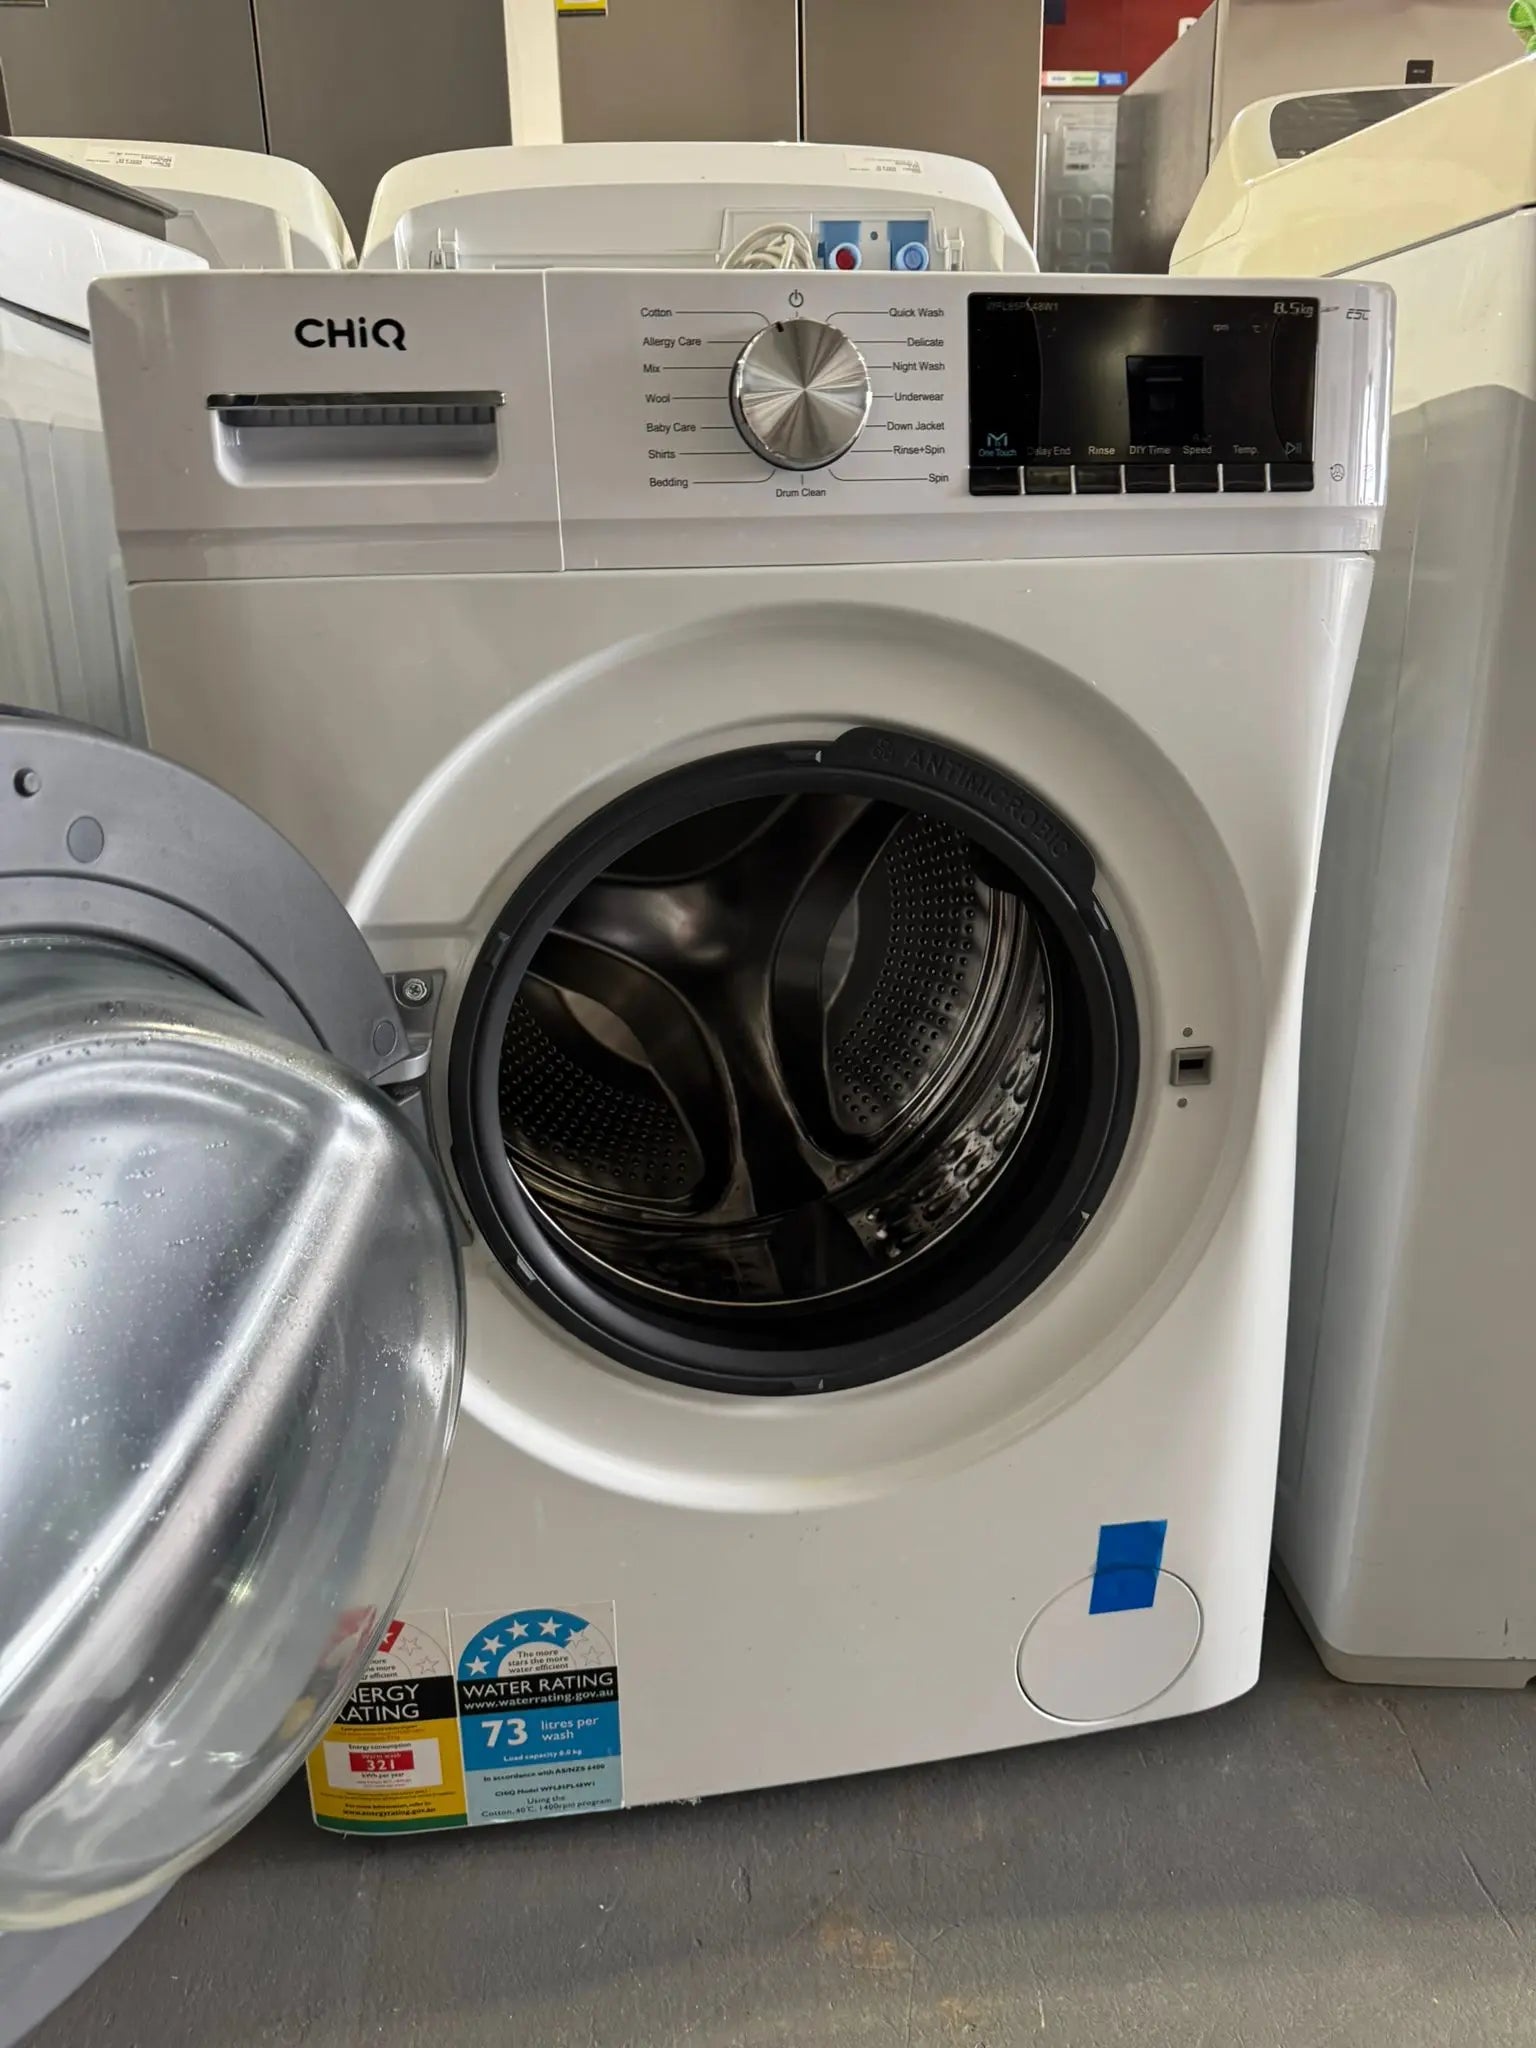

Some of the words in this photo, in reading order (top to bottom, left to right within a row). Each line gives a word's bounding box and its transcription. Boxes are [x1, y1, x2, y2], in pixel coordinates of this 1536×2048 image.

[640, 307, 673, 318] Cotton
[889, 307, 915, 318] Quick
[918, 307, 944, 317] Wash
[295, 316, 407, 351] CHiQ
[643, 336, 675, 348] Allergy
[678, 336, 702, 346] Care
[907, 337, 944, 347] Delicate
[643, 364, 660, 374] Mix
[892, 362, 916, 373] Night
[919, 362, 945, 371] Wash
[645, 394, 670, 403] Wool
[894, 392, 944, 401] Underwear
[646, 422, 671, 435] Baby
[674, 422, 696, 432] Care
[887, 421, 913, 431] Down
[915, 421, 945, 430] Jacket
[648, 450, 676, 459] Shirts
[893, 445, 945, 456] Rinse+Spin
[978, 448, 994, 457] One
[995, 448, 1017, 457] Touch
[1027, 446, 1052, 458] Delay
[1054, 445, 1072, 455] End
[1088, 445, 1116, 455] Rinse
[1129, 444, 1147, 455] DIY
[1149, 444, 1171, 455] Time
[1183, 445, 1213, 456] Speed
[649, 478, 688, 489] Bedding
[928, 473, 949, 484] Spin
[776, 488, 799, 498] Drum
[801, 488, 826, 497] Clean
[508, 1659, 528, 1667] stars
[535, 1662, 569, 1671] efficient
[463, 1679, 533, 1699] WATER
[539, 1672, 614, 1692] RATING
[349, 1684, 419, 1703] NERGY
[464, 1688, 614, 1711] www.waterrating.gov.au
[541, 1719, 574, 1731] litres
[577, 1717, 599, 1729] per
[481, 1718, 529, 1748] 73
[542, 1730, 575, 1741] wash
[367, 1759, 395, 1770] 321
